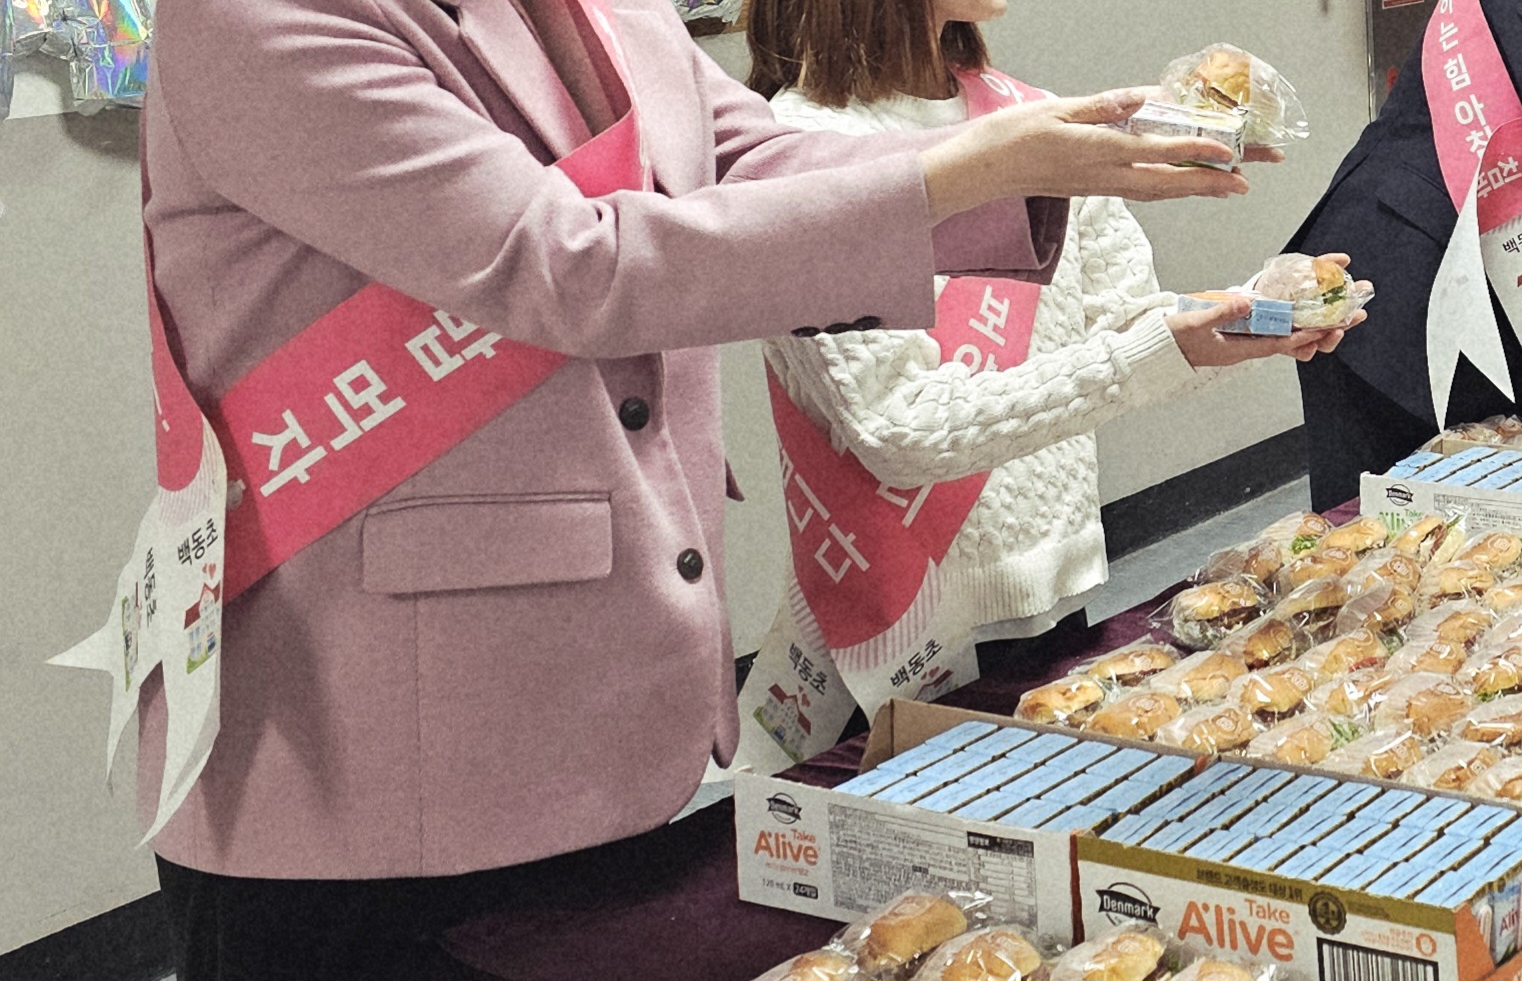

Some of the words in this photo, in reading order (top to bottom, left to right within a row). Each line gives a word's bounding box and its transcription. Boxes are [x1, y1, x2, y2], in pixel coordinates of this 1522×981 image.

[1443, 56, 1472, 92] 힘
[250, 359, 407, 498] 먹자
[177, 518, 220, 567] 백동초
[786, 640, 828, 697] 백동초
[890, 637, 944, 689] 백동초
[790, 828, 817, 844] Take
[1102, 894, 1154, 919] Denmark
[1243, 897, 1291, 925] Take
